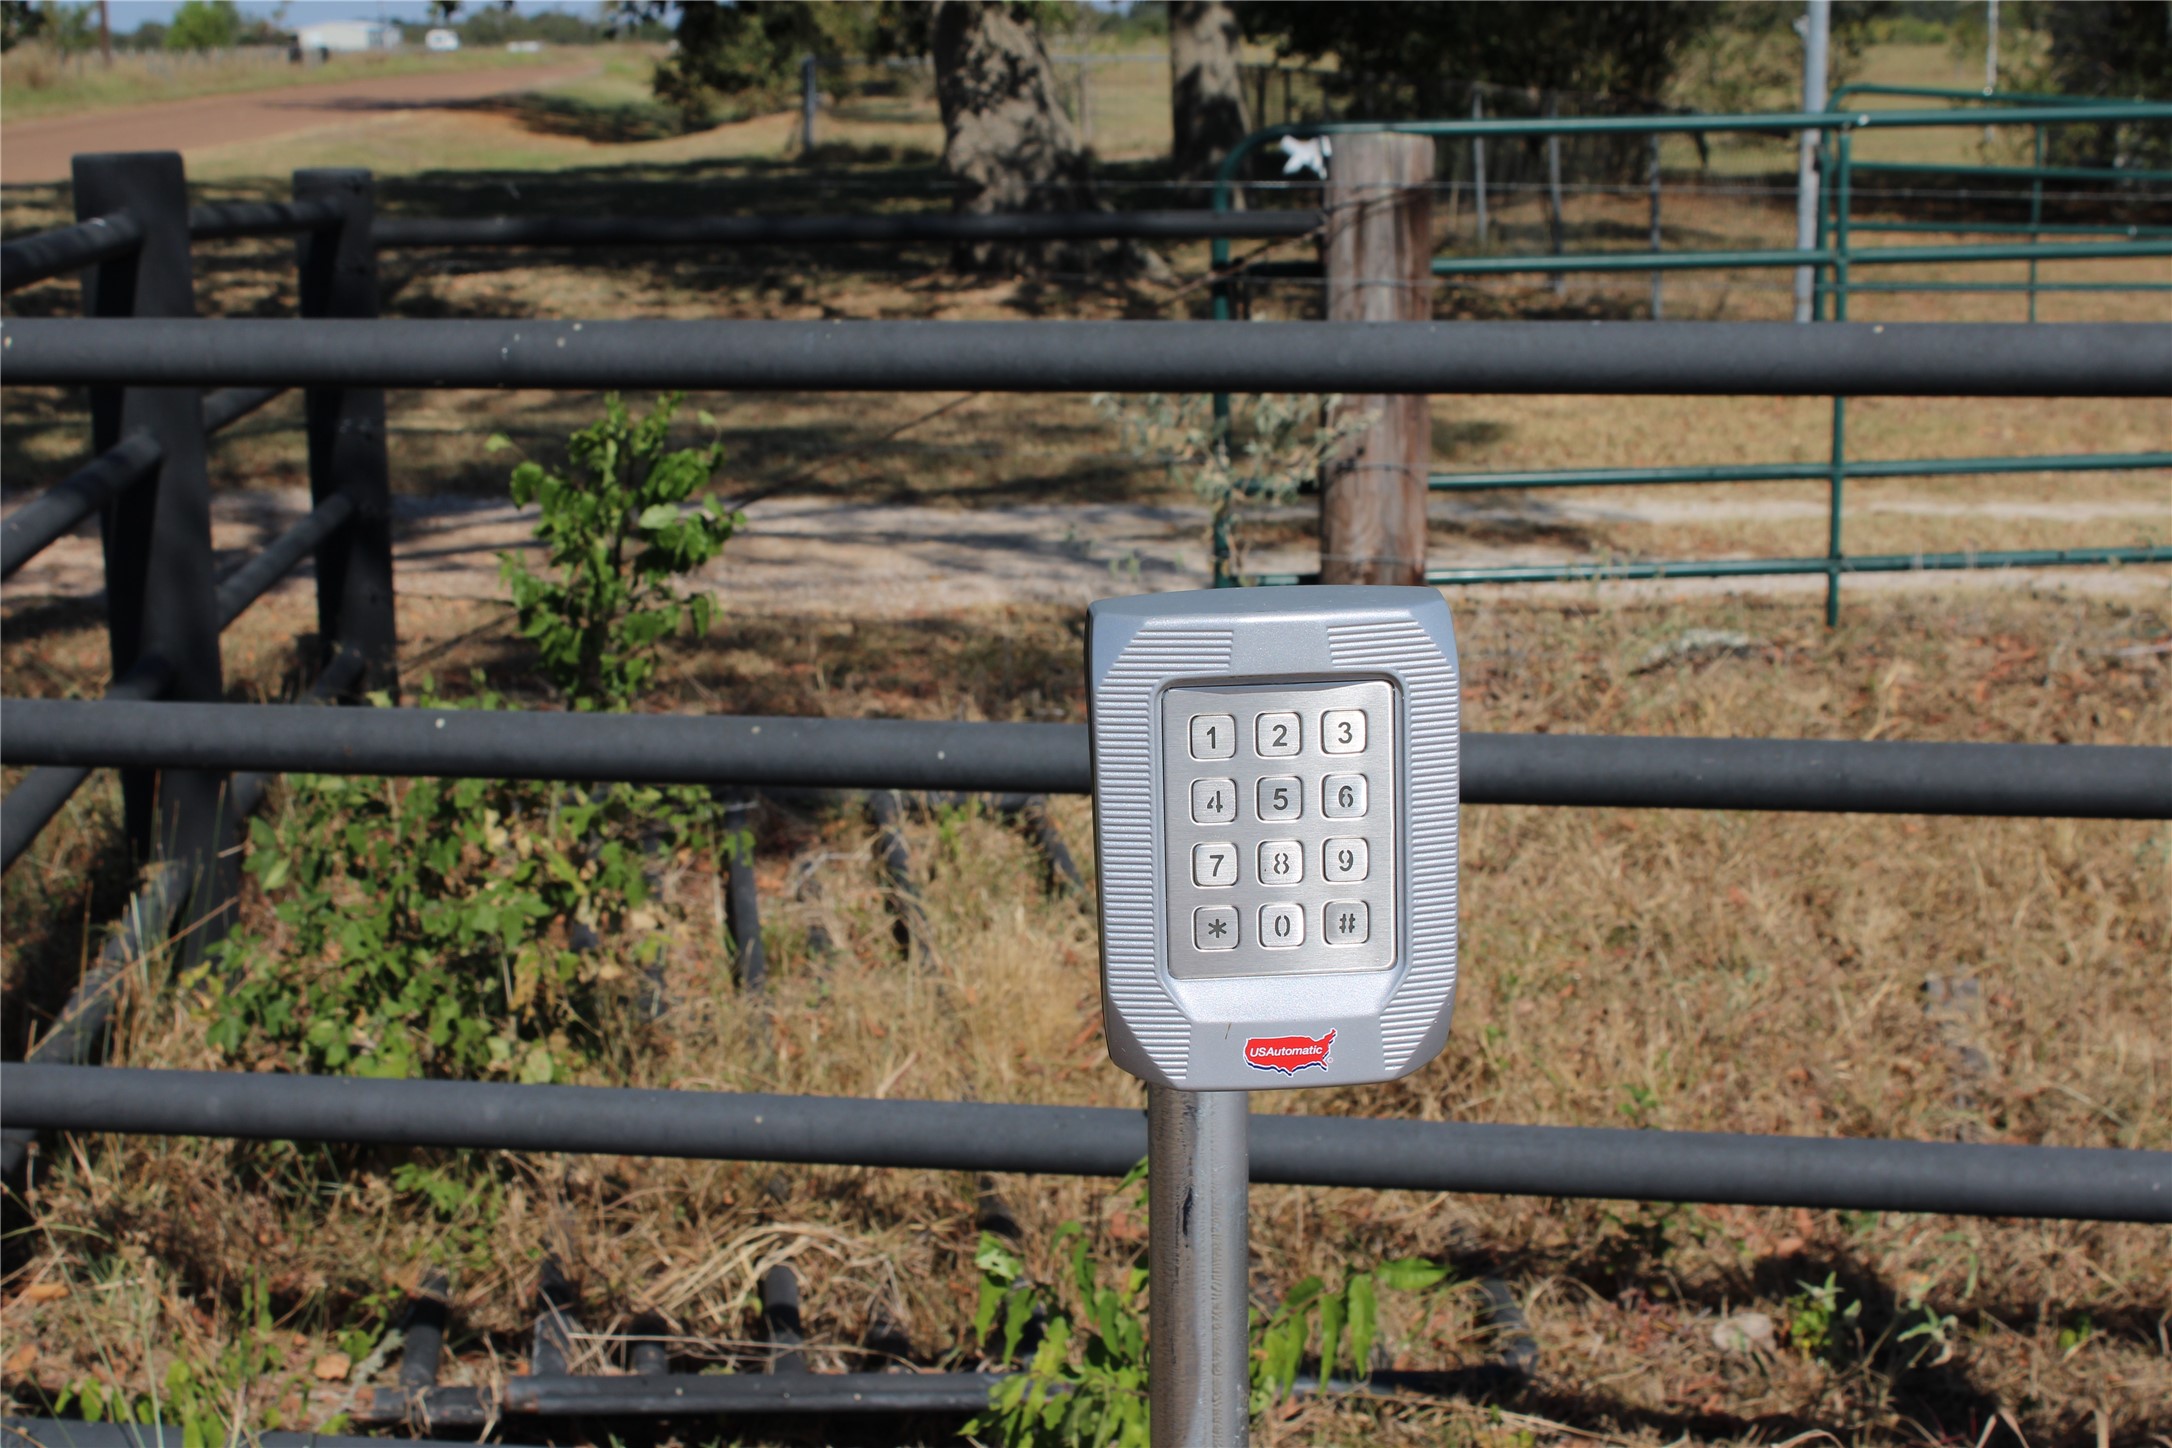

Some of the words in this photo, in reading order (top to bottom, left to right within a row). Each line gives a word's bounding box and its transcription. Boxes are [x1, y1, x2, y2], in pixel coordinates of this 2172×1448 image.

[1206, 726, 1217, 750] 1
[1272, 724, 1288, 747] 2
[1337, 721, 1353, 744] 3
[1206, 790, 1224, 814] 4
[1272, 787, 1289, 811] 5
[1338, 785, 1354, 808] 6
[1209, 854, 1225, 877] 7
[1273, 852, 1290, 875] 8
[1338, 849, 1354, 872] 9
[1274, 914, 1291, 938] 0
[1250, 1045, 1323, 1057] USAutomatic
